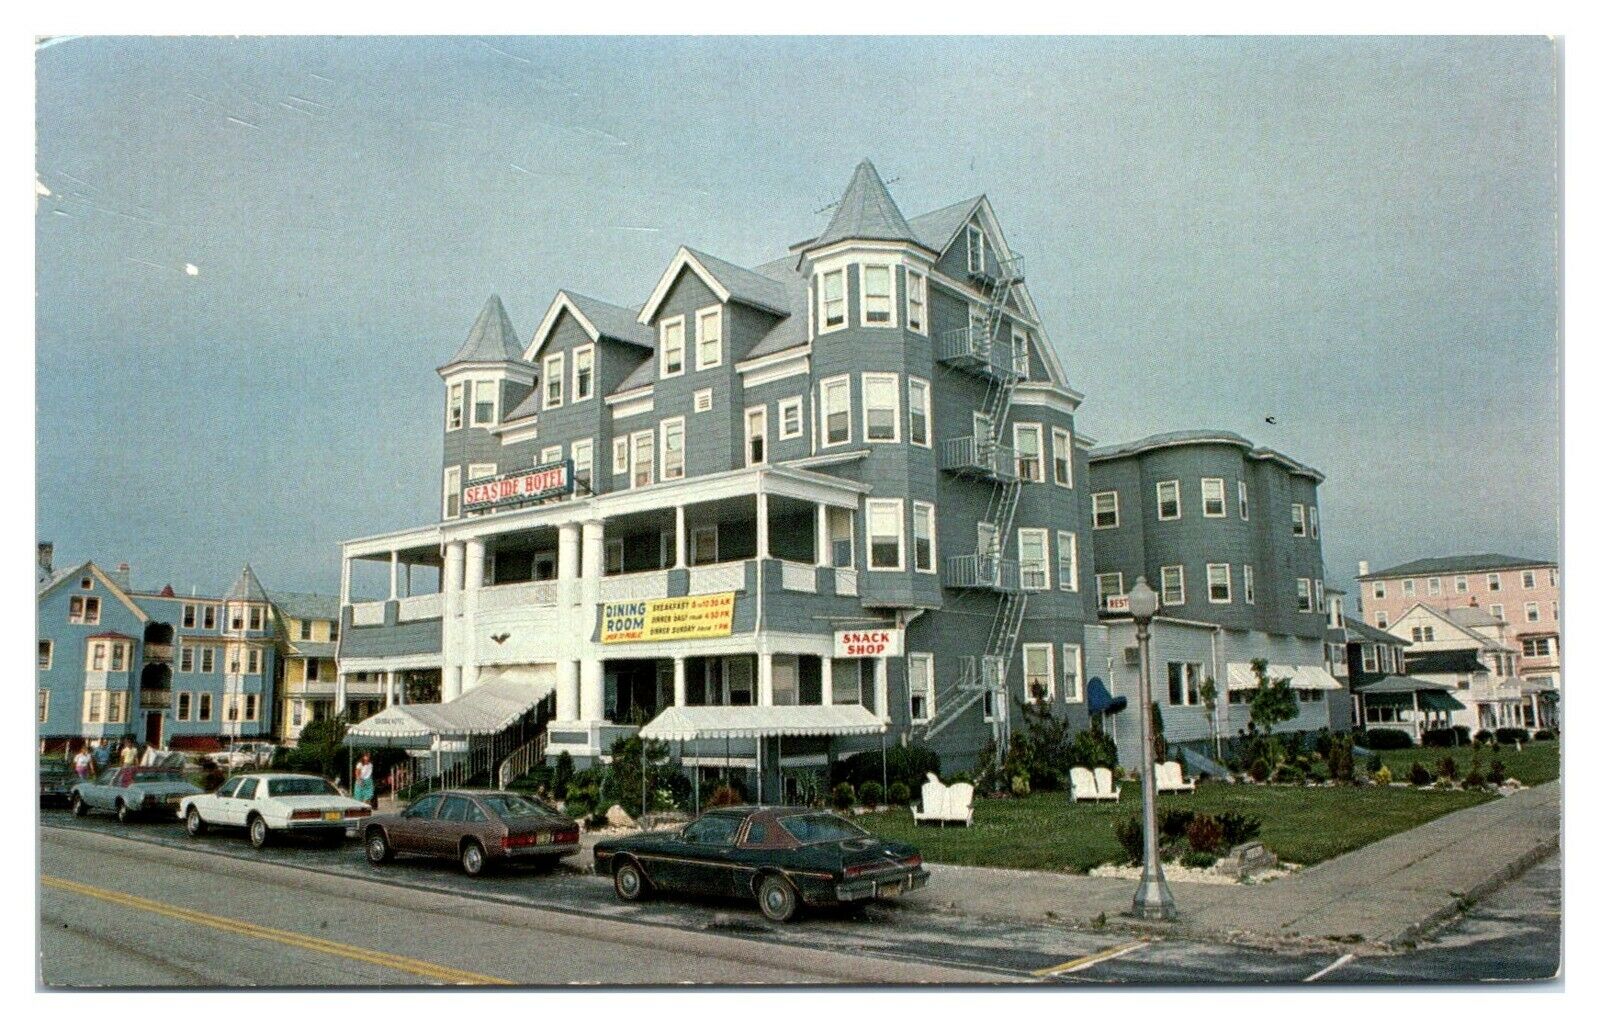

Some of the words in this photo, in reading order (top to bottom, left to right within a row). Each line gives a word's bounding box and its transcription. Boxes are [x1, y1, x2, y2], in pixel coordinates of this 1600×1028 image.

[466, 479, 520, 503] SEASIDE
[525, 469, 565, 492] HOTEL
[606, 602, 646, 617] DINING
[652, 601, 689, 612] BREAKFAST
[607, 617, 645, 632] ROOM
[842, 633, 889, 643] SNACK
[847, 645, 885, 655] SHOP
